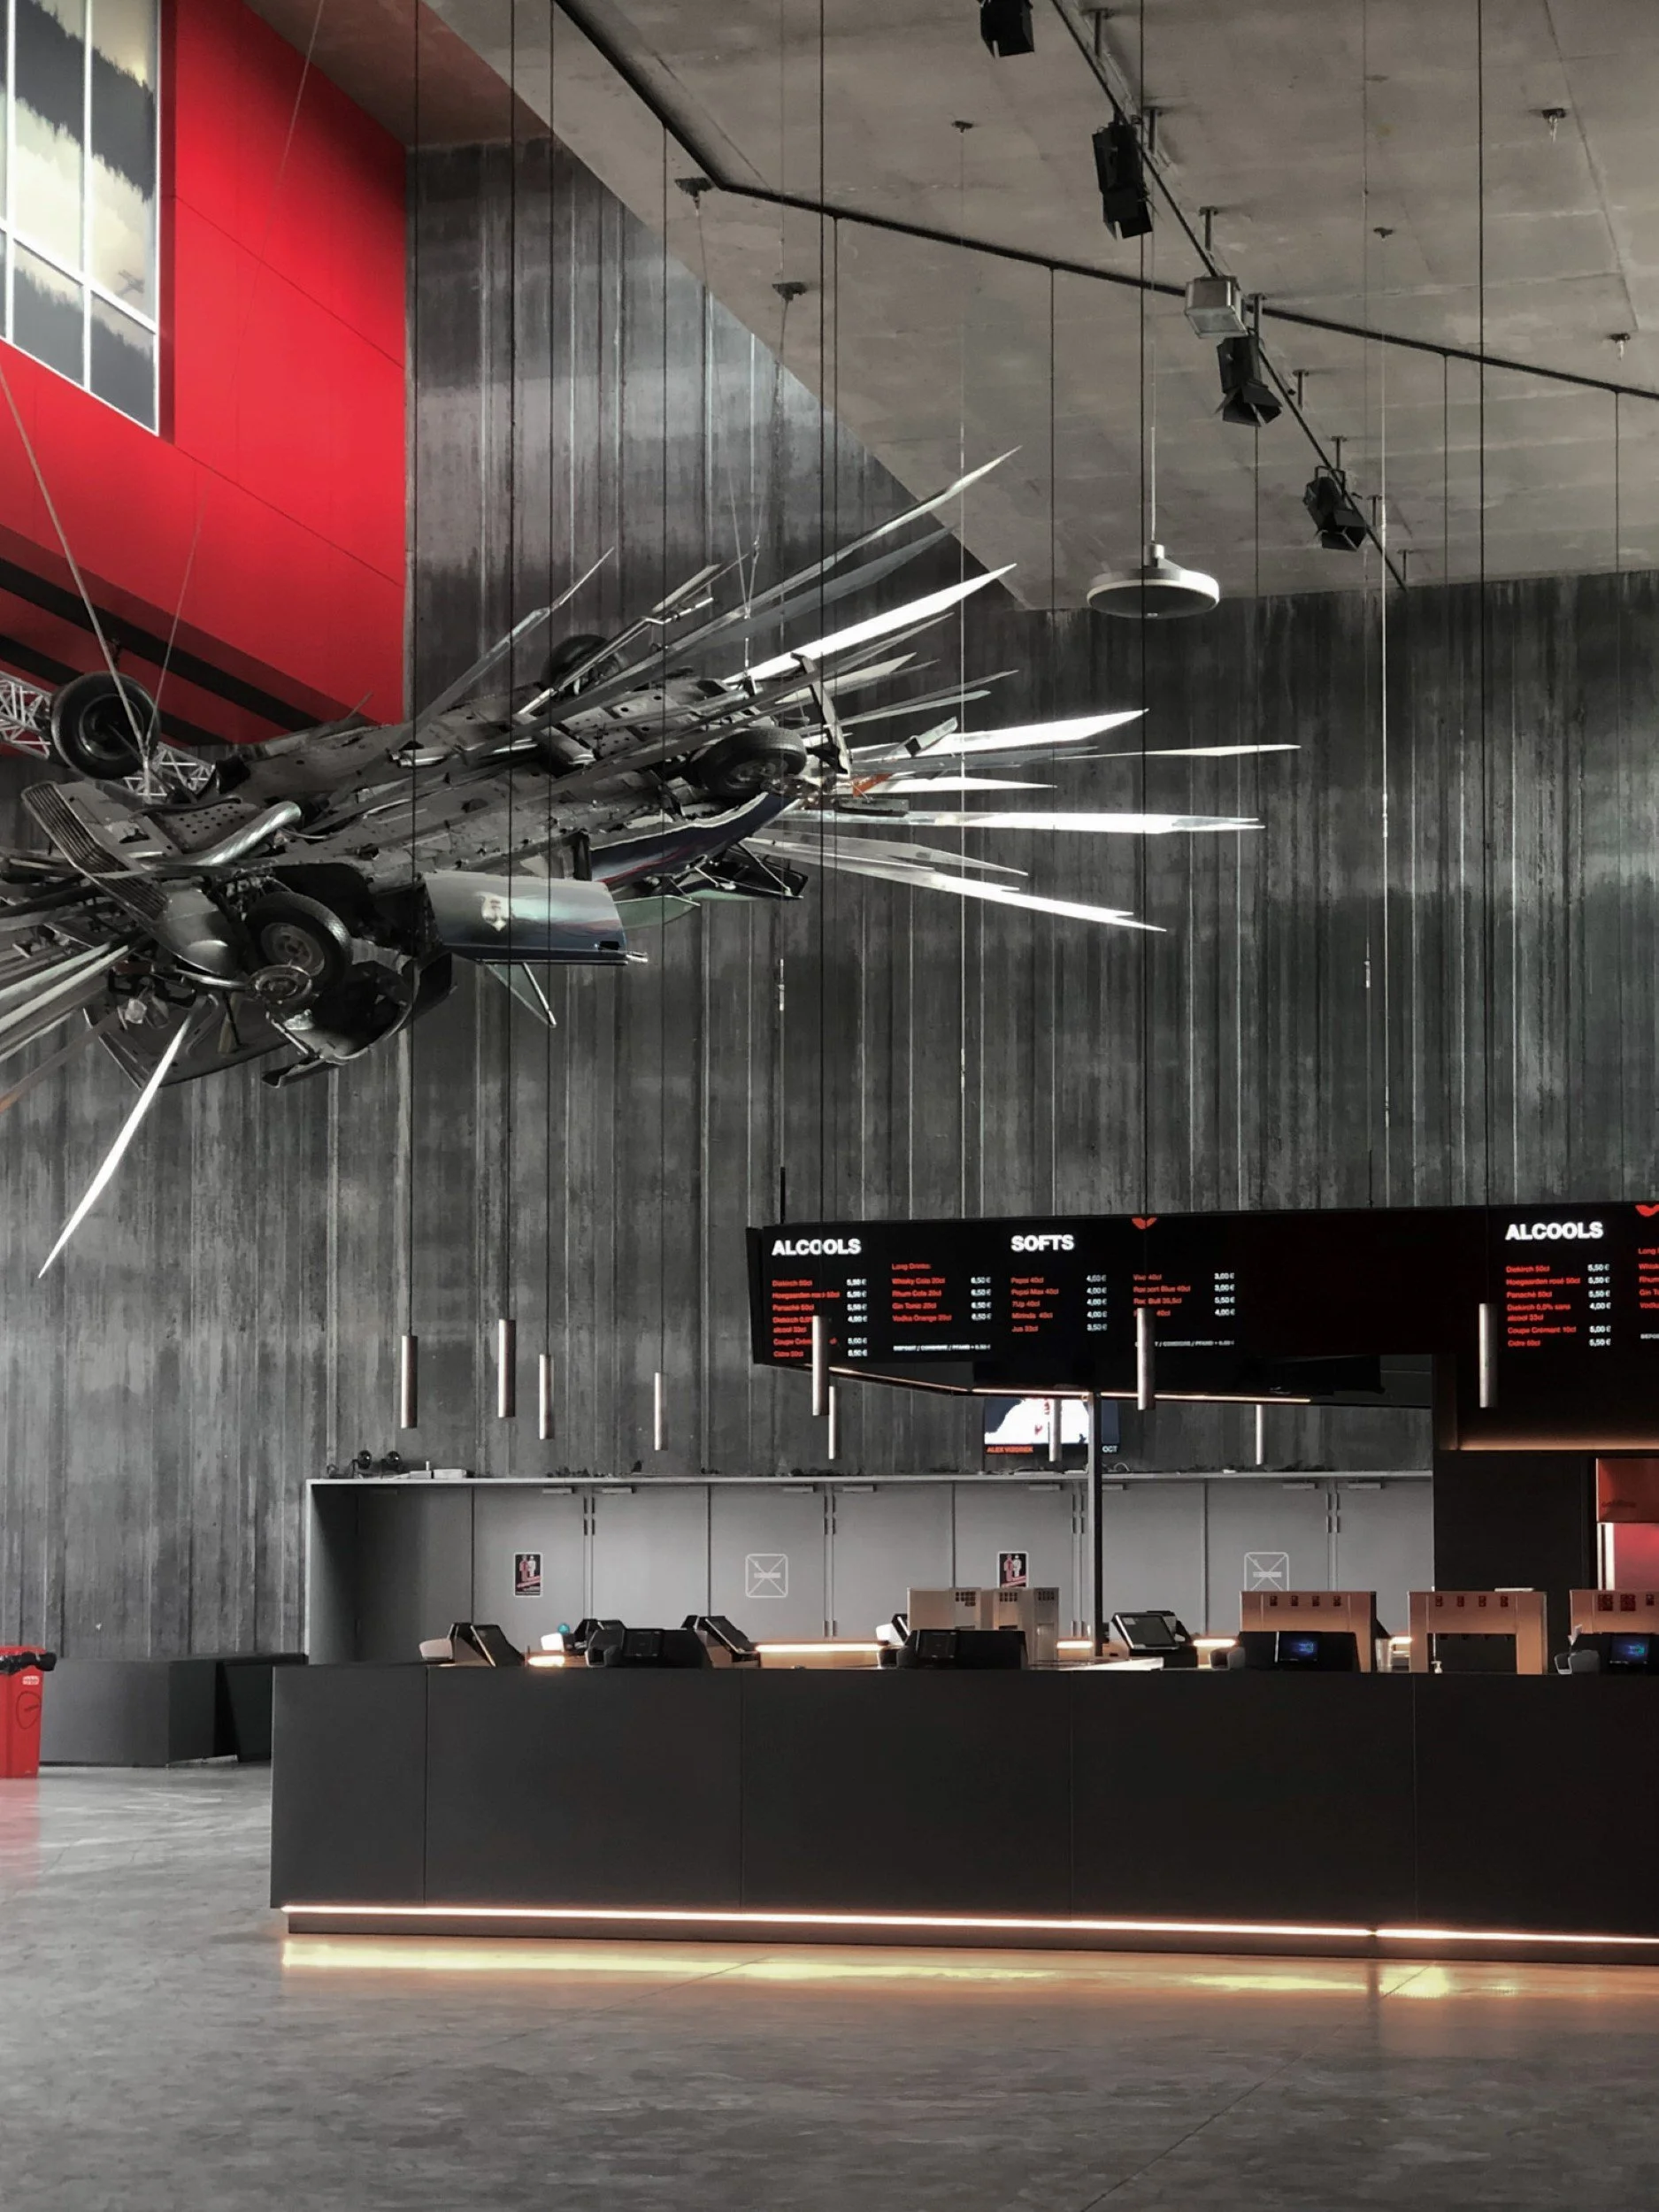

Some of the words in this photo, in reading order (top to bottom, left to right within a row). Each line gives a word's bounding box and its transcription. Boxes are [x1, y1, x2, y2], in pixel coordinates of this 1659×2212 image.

[1505, 1221, 1603, 1240] ALCOOLS
[772, 1239, 862, 1256] ALCOOLS
[1010, 1234, 1074, 1251] SOFTS
